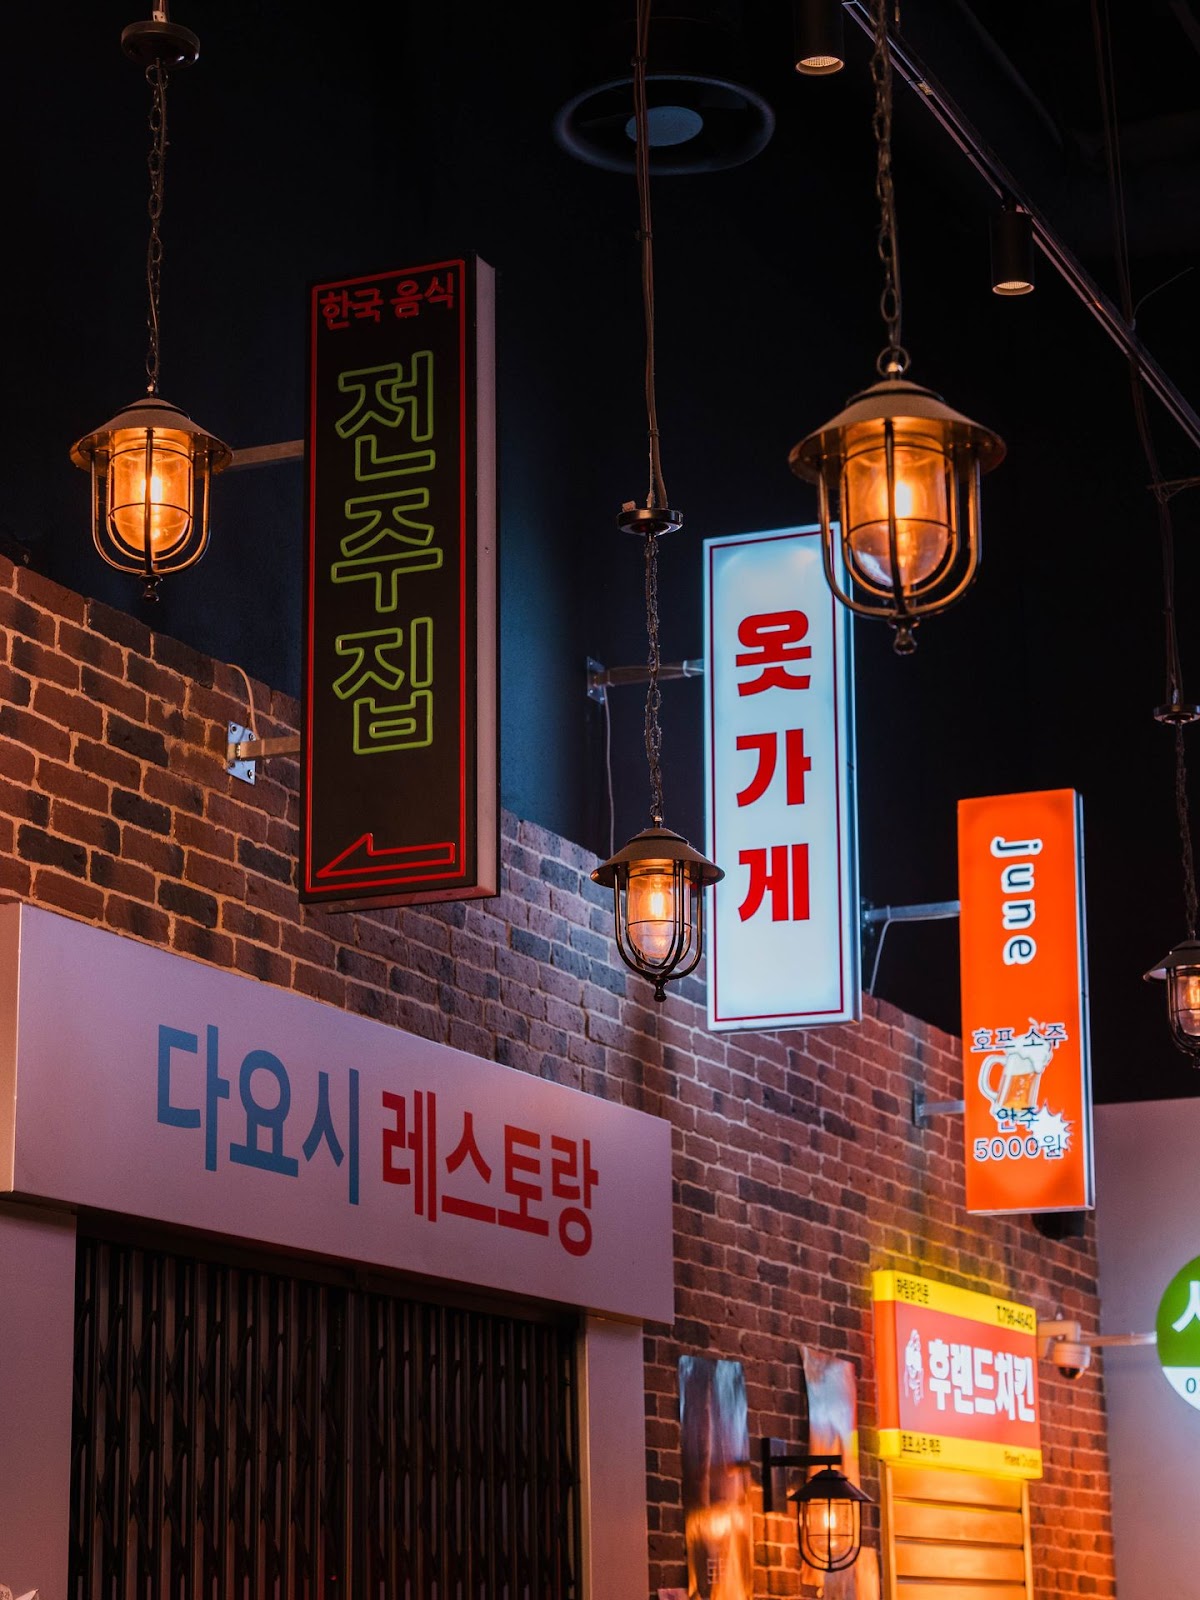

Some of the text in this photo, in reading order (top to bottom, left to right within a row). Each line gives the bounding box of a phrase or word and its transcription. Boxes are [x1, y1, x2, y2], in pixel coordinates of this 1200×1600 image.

[319, 271, 455, 331] 한국 음식
[330, 350, 444, 756] 전주집
[735, 609, 812, 923] 옷가게
[994, 838, 1040, 962] june
[971, 1023, 1067, 1052] 호프 소주
[156, 1023, 599, 1257] 다요시 레스토랑
[974, 1132, 1062, 1160] 5000원
[995, 1105, 1040, 1131] 안주
